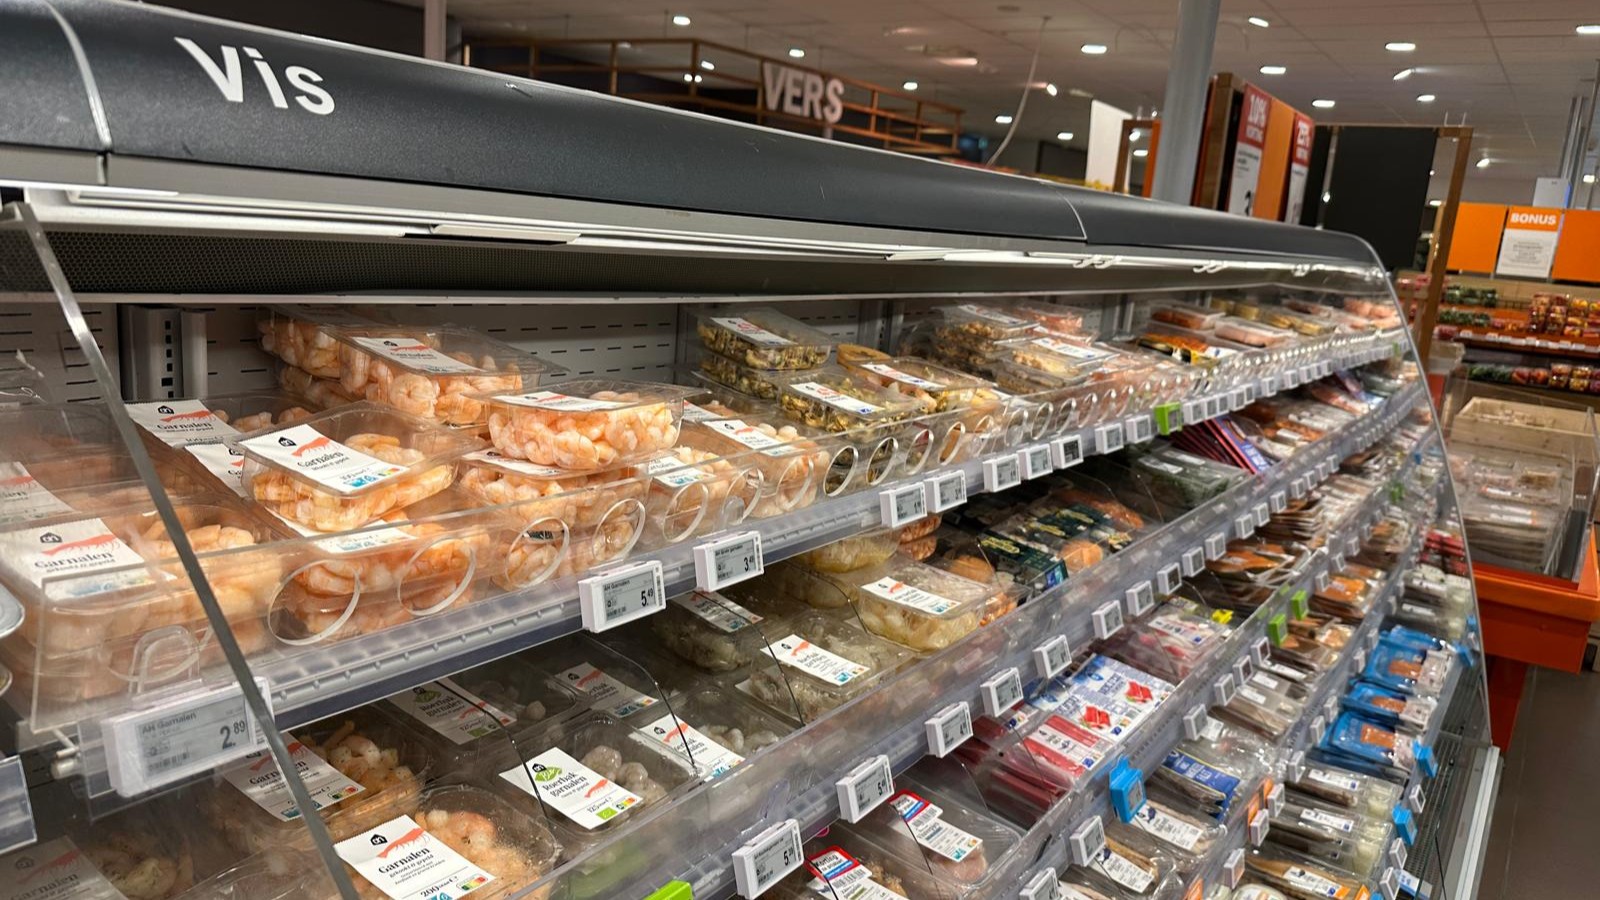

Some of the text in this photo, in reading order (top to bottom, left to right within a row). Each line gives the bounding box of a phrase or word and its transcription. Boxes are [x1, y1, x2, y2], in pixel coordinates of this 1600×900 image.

[174, 36, 335, 115] Vis
[763, 61, 844, 123] VERS
[1510, 212, 1557, 226] BONUS
[296, 450, 345, 467] Garnalen
[34, 551, 114, 570] Garnalen
[641, 588, 654, 607] 5.49
[158, 711, 198, 730] Garnalen
[219, 719, 246, 750] 2.89
[542, 771, 579, 792] Roerbak
[549, 775, 588, 797] garnalen
[379, 847, 430, 874] Garnalen
